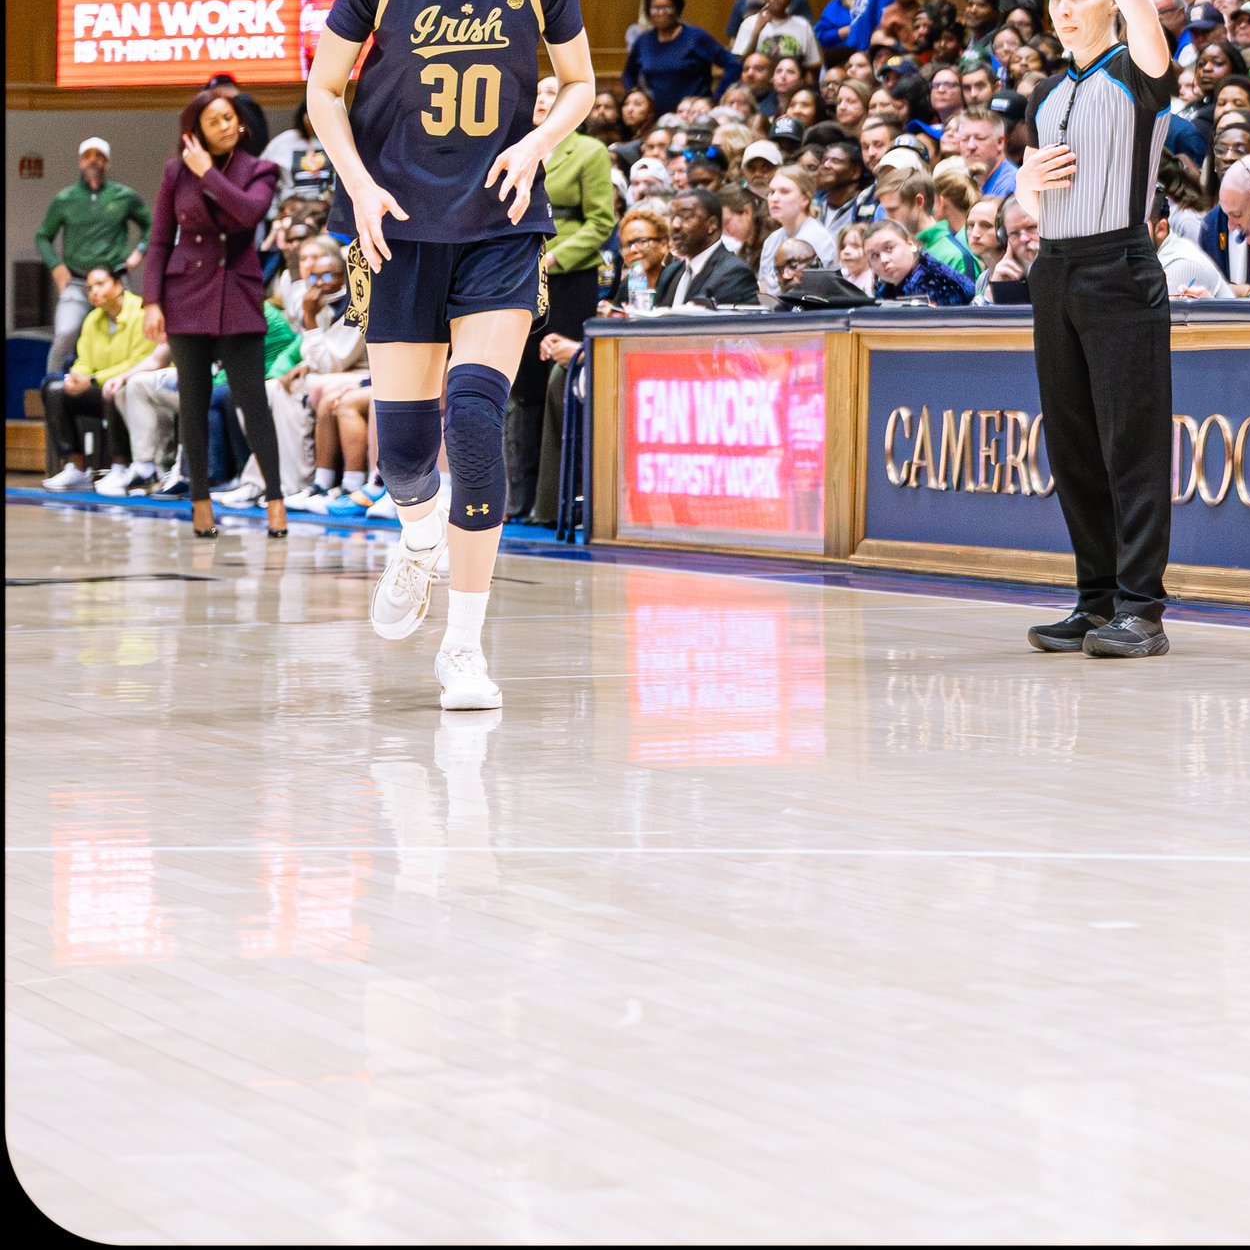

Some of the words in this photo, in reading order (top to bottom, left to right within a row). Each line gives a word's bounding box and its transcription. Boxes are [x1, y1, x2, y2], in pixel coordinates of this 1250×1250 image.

[74, 2, 151, 38] FAN
[410, 4, 510, 59] Irish
[74, 40, 98, 63] IS
[99, 37, 204, 62] THIRSTY
[206, 35, 286, 60] WORK
[420, 63, 502, 137] 30
[637, 379, 690, 444] FAN
[692, 379, 781, 447] WORK
[637, 453, 656, 493] IS
[656, 454, 724, 497] THIRSTY
[724, 456, 781, 499] WORK
[884, 404, 1055, 499] CAMERO
